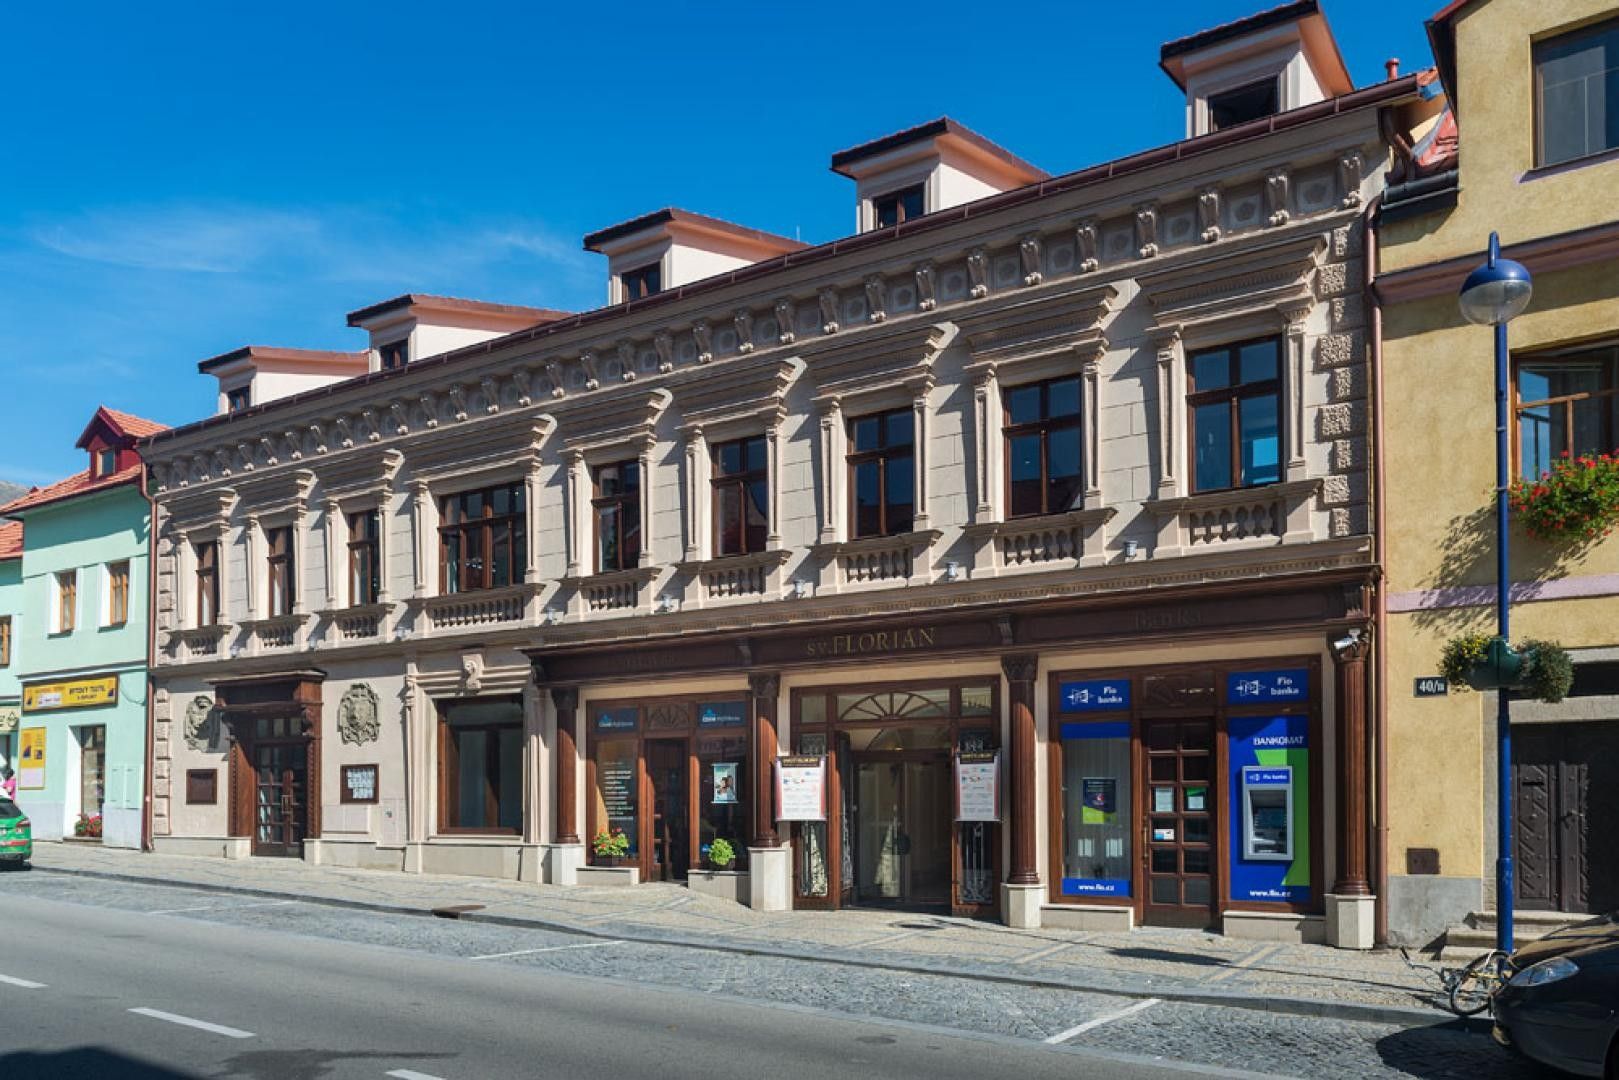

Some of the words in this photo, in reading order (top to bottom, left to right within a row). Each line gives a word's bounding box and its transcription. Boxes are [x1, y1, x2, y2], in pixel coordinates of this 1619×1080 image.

[1276, 677, 1293, 686] Fio
[1103, 686, 1118, 695] Fio
[1270, 687, 1299, 696] banka
[1097, 696, 1123, 704] banka
[1253, 736, 1304, 746] BANKOMAT
